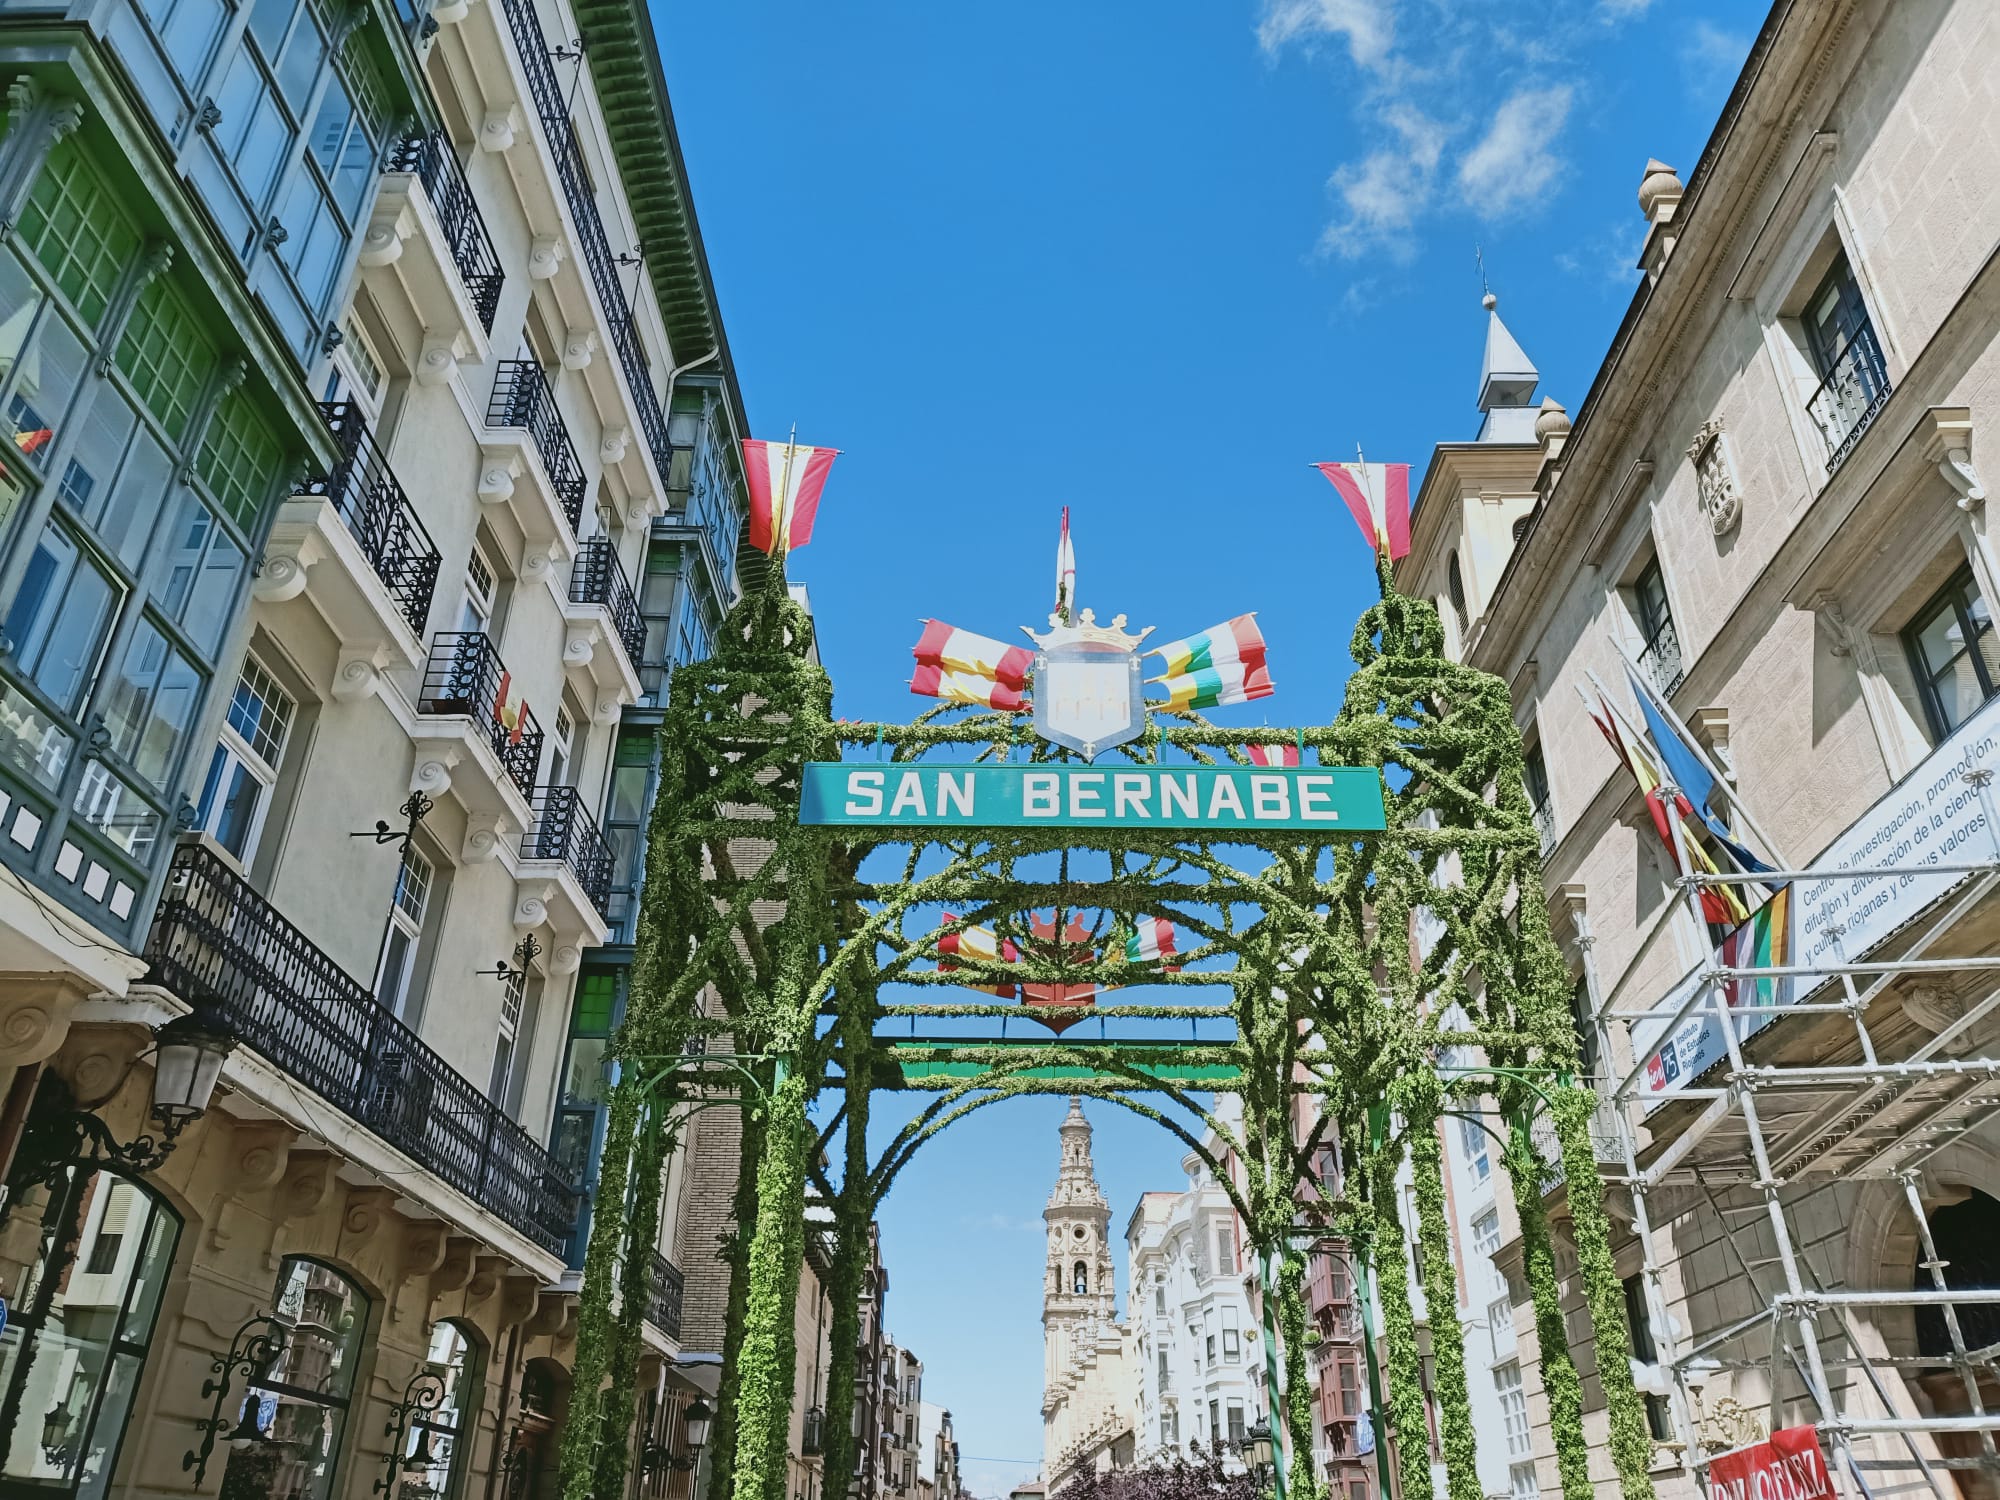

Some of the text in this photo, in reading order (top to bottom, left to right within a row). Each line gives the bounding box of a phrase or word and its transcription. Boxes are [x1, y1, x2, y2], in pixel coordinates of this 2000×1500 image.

[845, 771, 1339, 821] SAN BERNABE
[1850, 800, 1925, 867] investigación,
[1926, 737, 1998, 807] promocón,
[1804, 897, 1842, 934] difusón
[1842, 890, 1850, 907] y
[1914, 826, 1929, 845] de
[1929, 814, 1944, 831] la
[1805, 949, 1812, 967] y
[1847, 890, 1889, 930] riojanas
[1889, 882, 1897, 901] y
[1939, 814, 1986, 856] valores
[1687, 1029, 1710, 1052] Estudios
